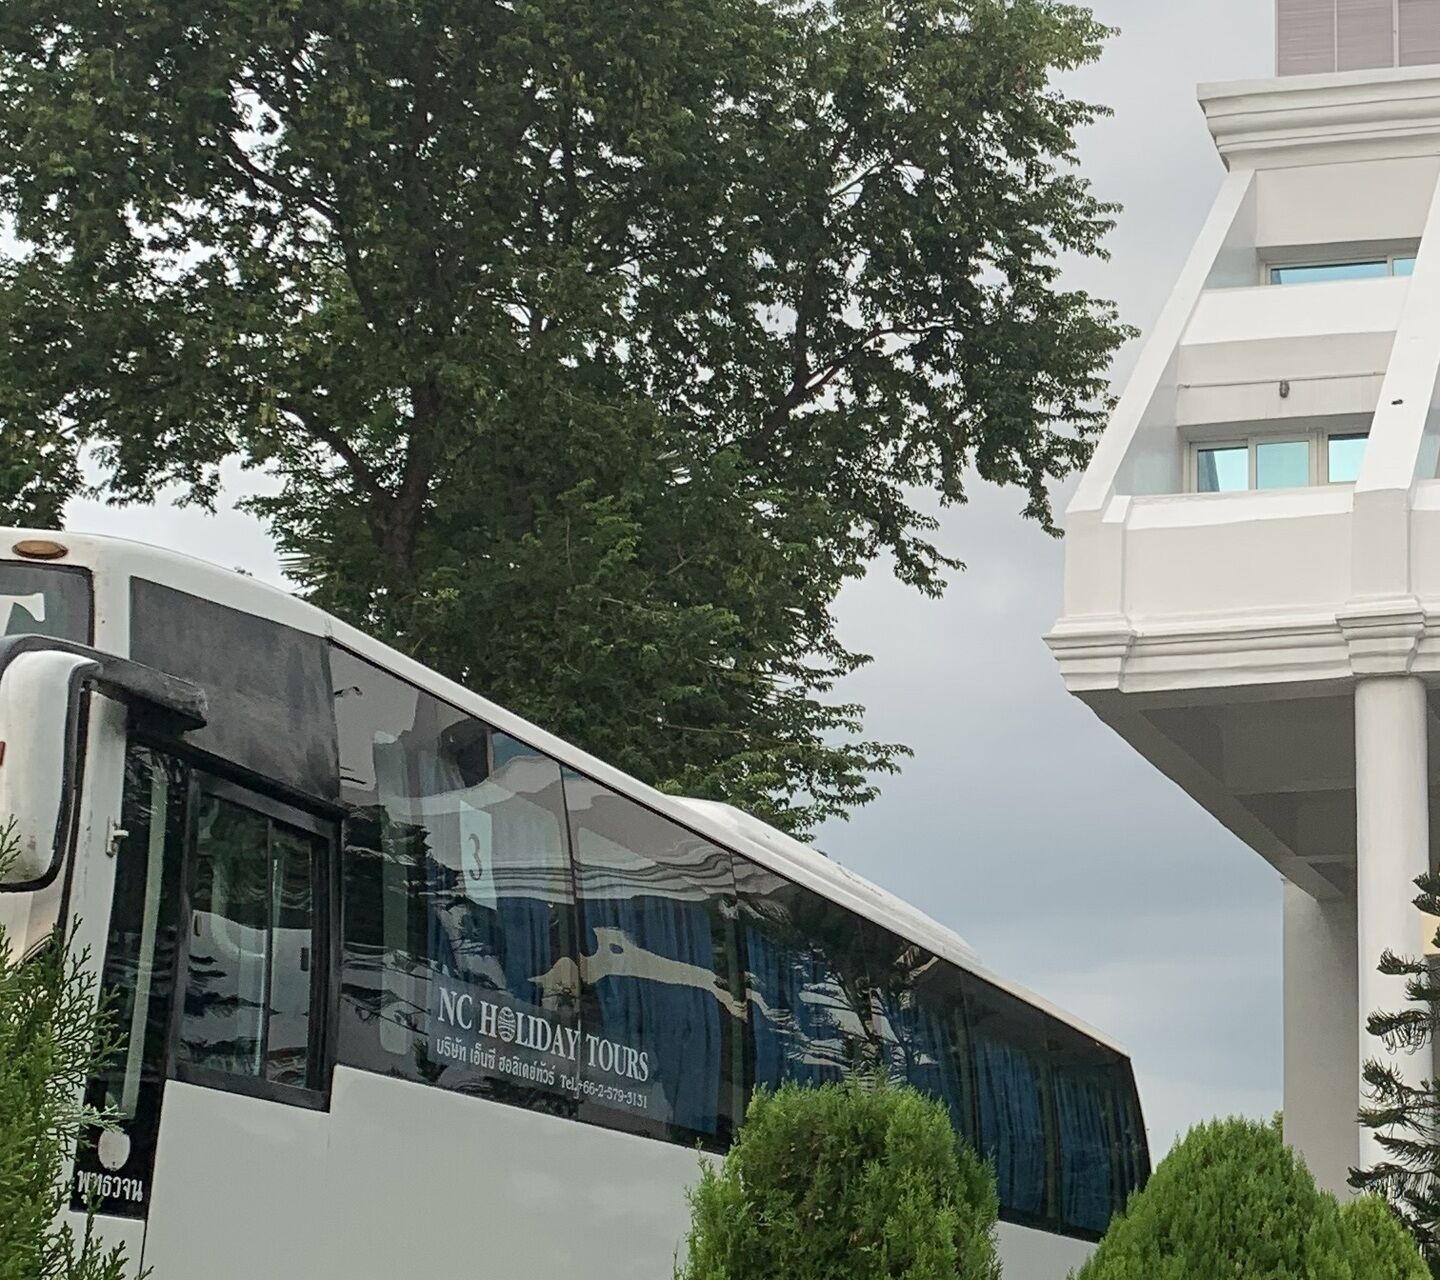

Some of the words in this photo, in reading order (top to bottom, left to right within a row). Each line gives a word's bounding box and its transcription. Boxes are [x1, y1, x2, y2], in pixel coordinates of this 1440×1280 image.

[468, 833, 483, 881] 3
[436, 1036, 467, 1063] บริษัท
[469, 1042, 497, 1070] เอ็นซี
[437, 986, 473, 1030] NC
[478, 1000, 581, 1061] HOLIDAY
[585, 1033, 649, 1083] TOURS
